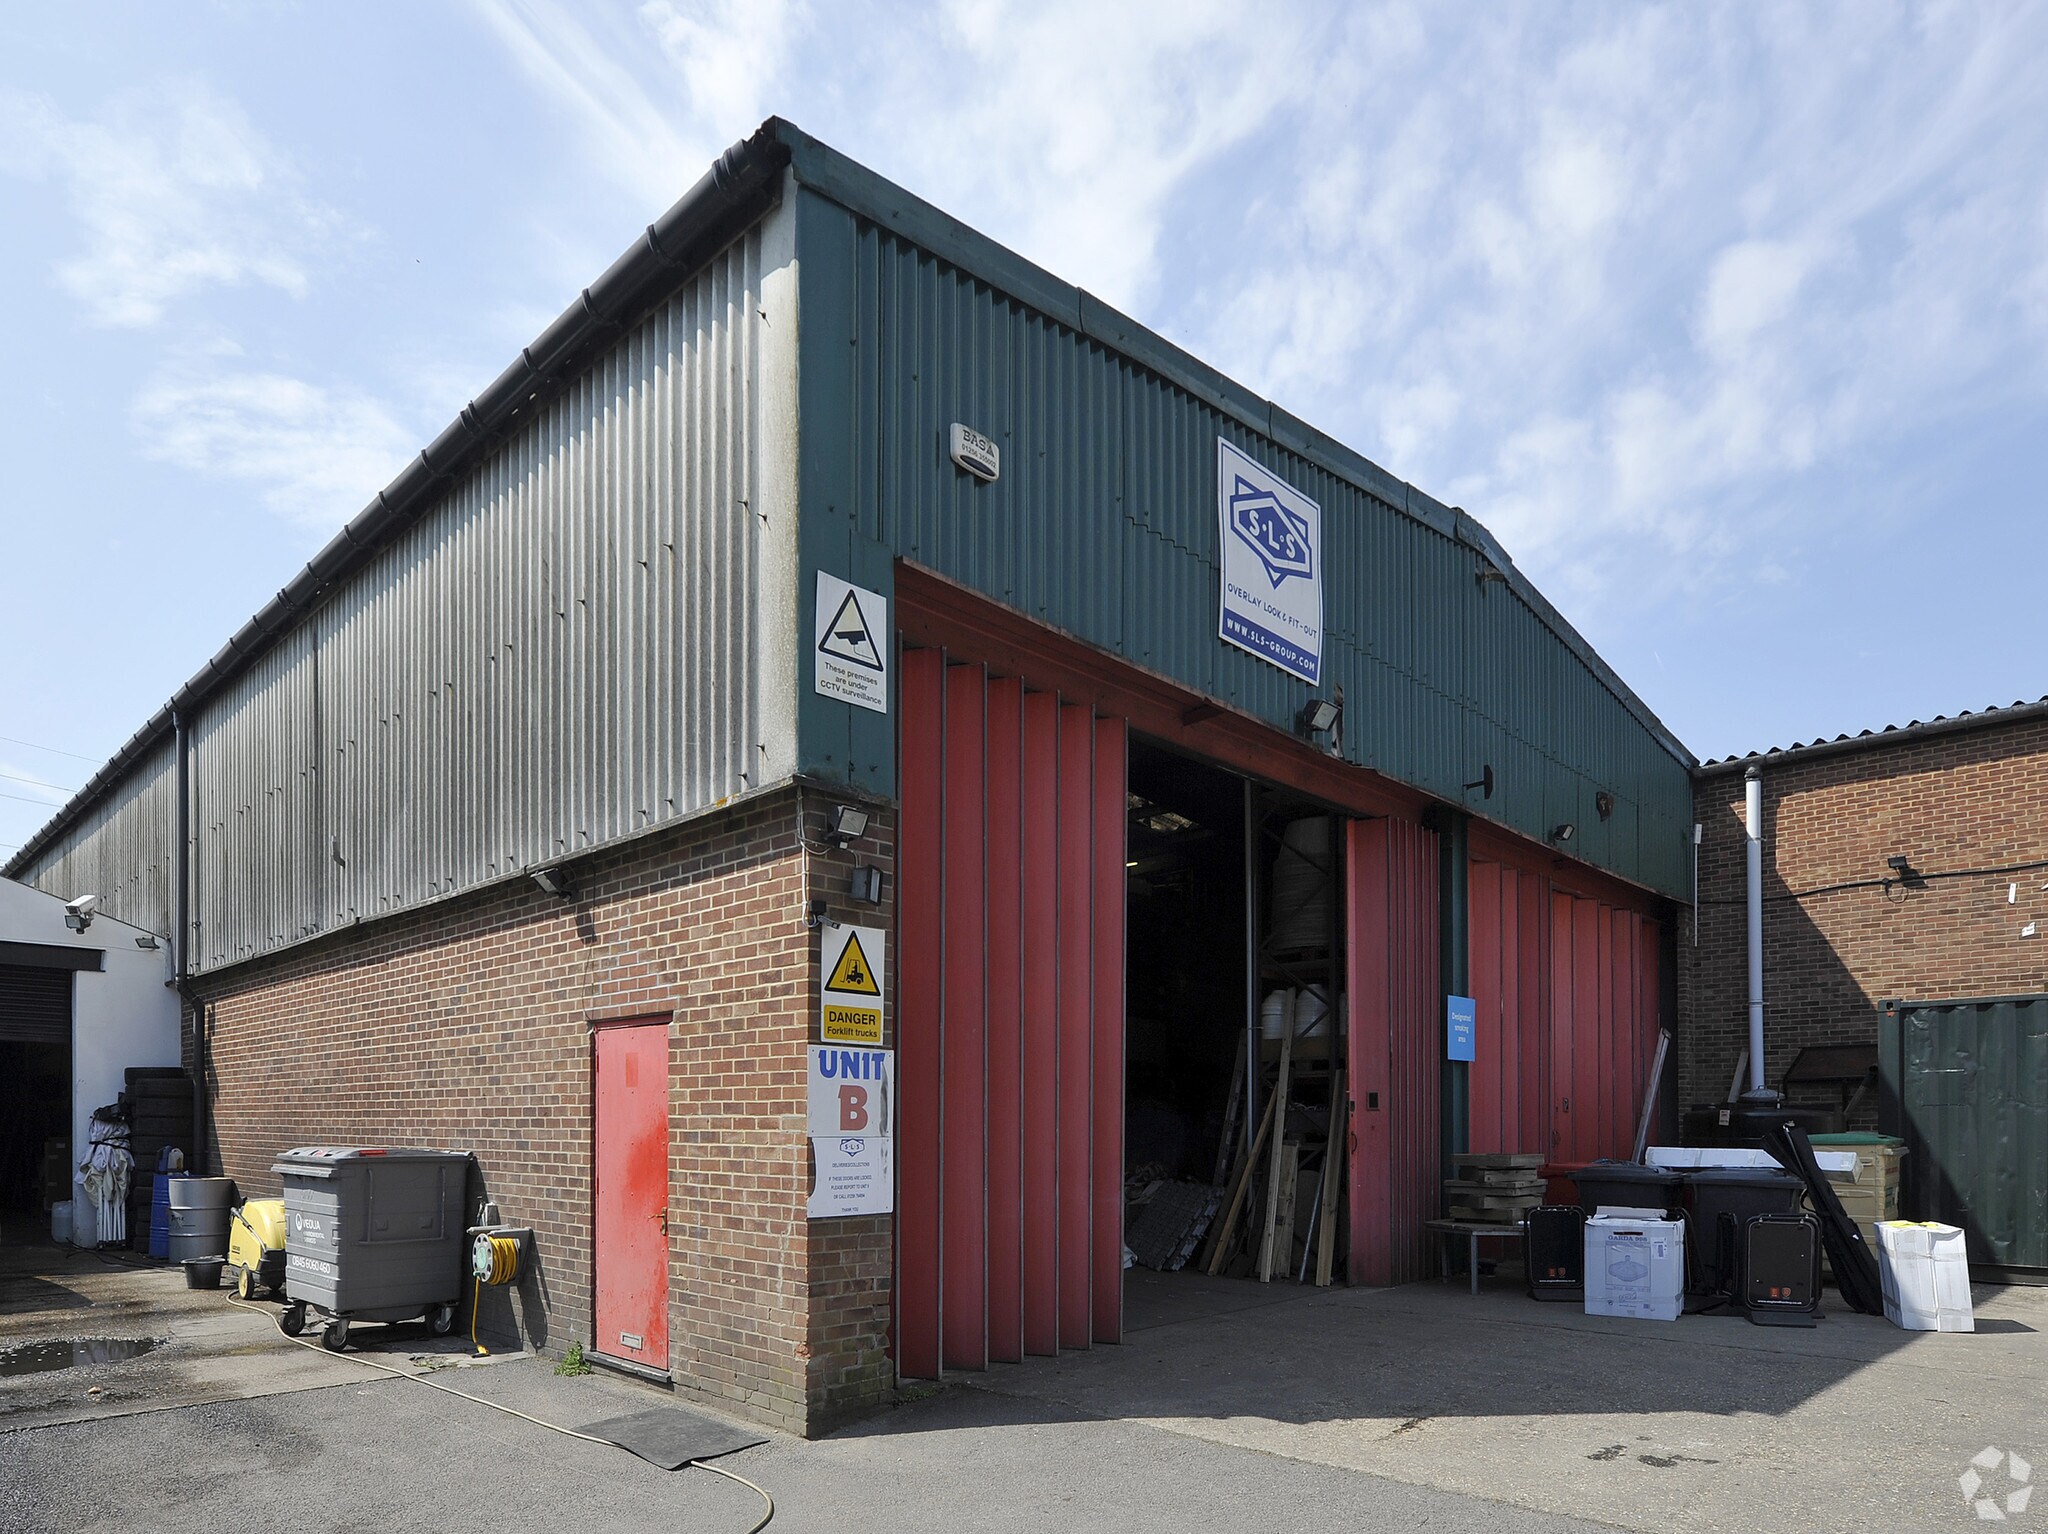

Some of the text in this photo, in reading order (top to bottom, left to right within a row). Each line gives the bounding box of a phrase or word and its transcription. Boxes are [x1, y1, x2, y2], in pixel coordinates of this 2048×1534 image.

[1227, 583, 1262, 607] OVERLAY
[1263, 602, 1281, 620] LOOK
[1288, 616, 1317, 639] FIT-OUT
[1226, 617, 1315, 672] WWW.SLS-GROUP.COM
[825, 661, 878, 686] These premises
[820, 679, 882, 705] CCTV surveillance
[835, 676, 868, 692] are under
[829, 1011, 876, 1026] DANGER
[1451, 1012, 1472, 1022] Designated
[827, 1026, 878, 1038] Forklift trucks
[1454, 1025, 1469, 1034] smoking
[818, 1050, 885, 1080] UNIT
[838, 1085, 868, 1131] B
[303, 1219, 320, 1230] VEOLIA
[292, 1255, 305, 1268] 0845
[305, 1258, 319, 1271] 6060
